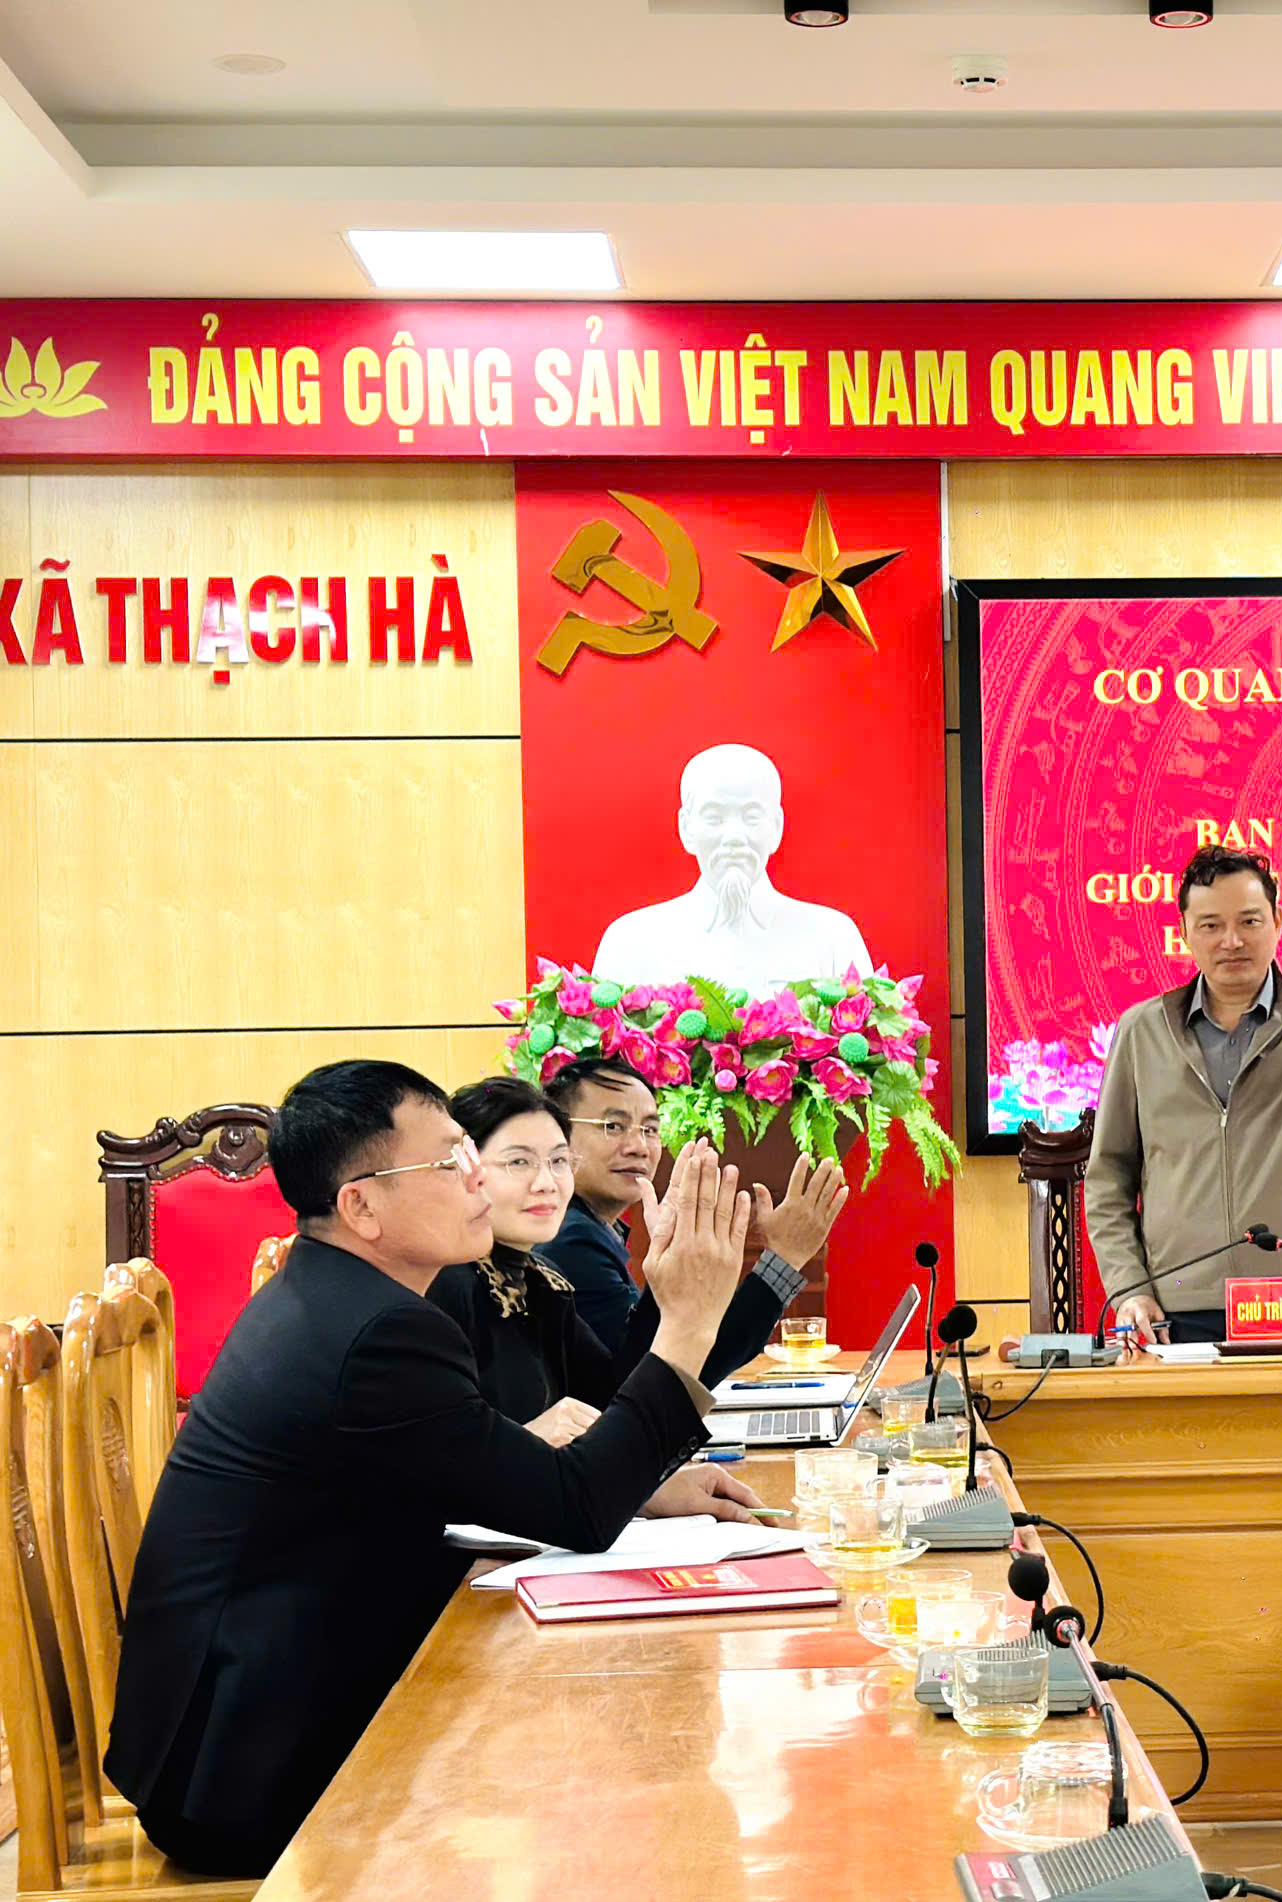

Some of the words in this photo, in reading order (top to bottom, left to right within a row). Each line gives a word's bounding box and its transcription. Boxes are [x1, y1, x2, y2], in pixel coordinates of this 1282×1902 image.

[147, 312, 321, 425] ĐẢNG
[343, 331, 513, 443] CỘNG
[534, 315, 660, 426] SẢN
[679, 333, 807, 444] VIỆT
[828, 350, 968, 426] NAM
[990, 349, 1194, 435] QUANG
[96, 575, 349, 685] THẠCH
[368, 553, 473, 664] HÀ
[1093, 666, 1164, 705] CƠ
[1195, 817, 1273, 849] BAN
[1086, 864, 1176, 903] GIỚI
[1237, 1294, 1263, 1323] CHỦ
